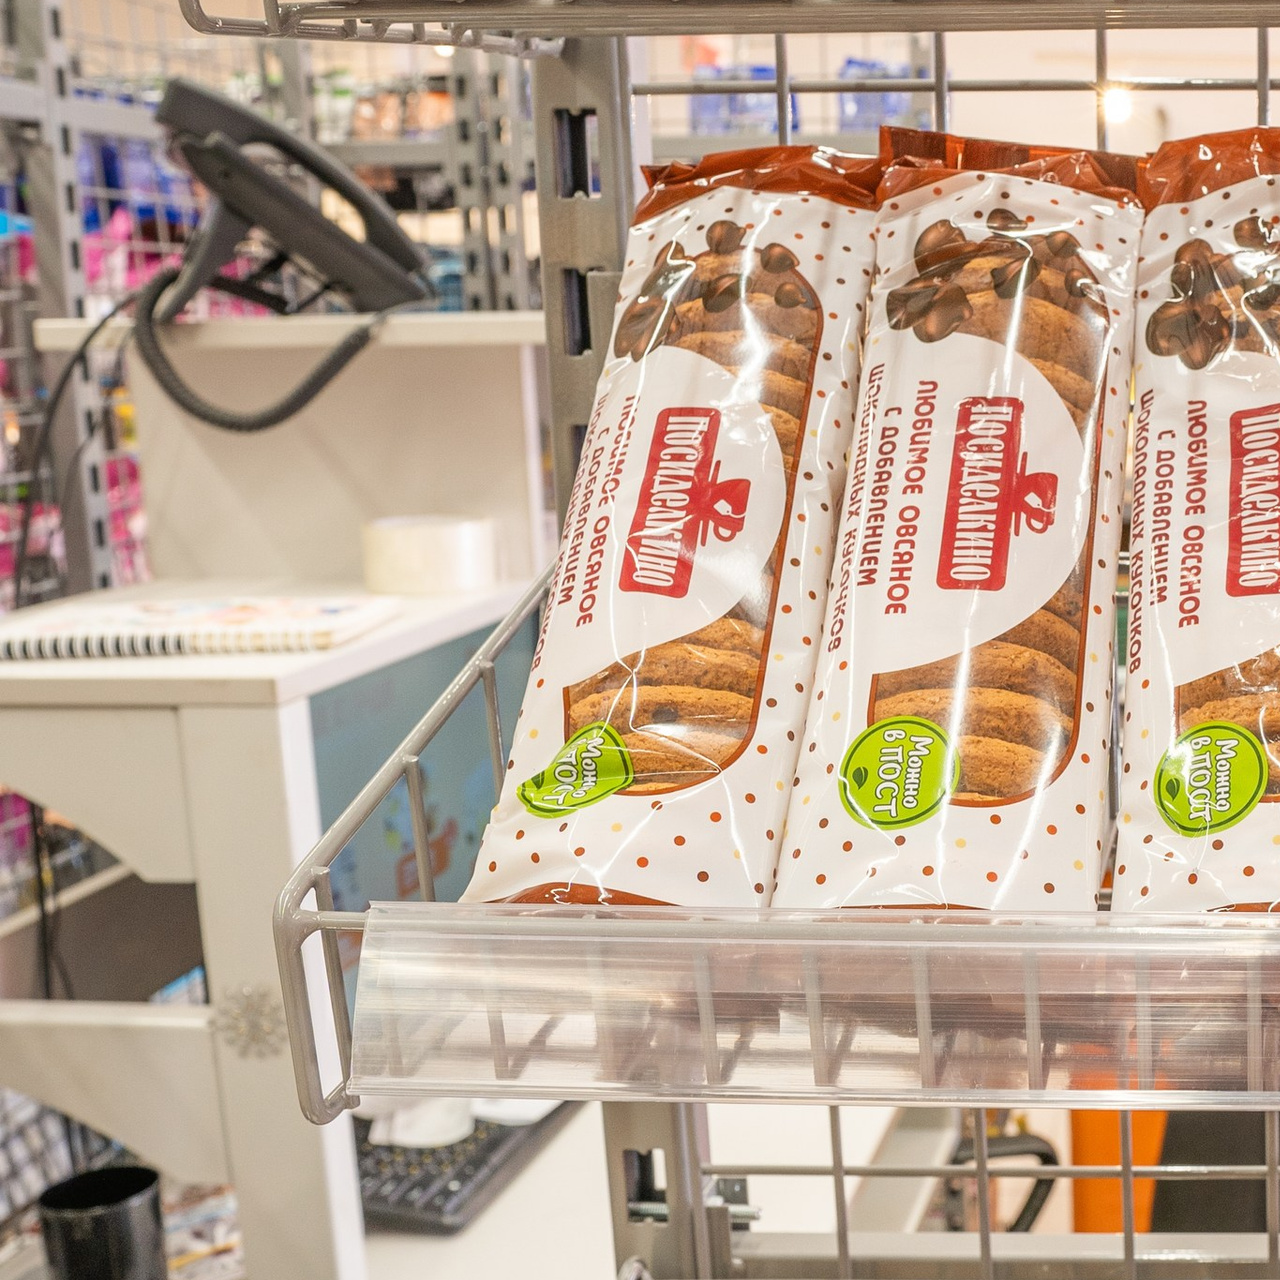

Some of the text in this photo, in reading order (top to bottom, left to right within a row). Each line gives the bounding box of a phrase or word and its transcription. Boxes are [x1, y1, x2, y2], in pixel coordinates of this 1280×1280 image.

[556, 426, 610, 607] С ДОБАВЛЕНИЕМ
[633, 414, 711, 589] ПОСИДЕЛКИНО
[856, 406, 902, 586] С ДОБАВЛЕНИЕМ
[884, 380, 939, 615] ЛЮБИМОЕ ОВСЯНОЕ
[950, 405, 1014, 582] ПОСИДЕЛКИНО
[1129, 387, 1154, 546] ШОКОЛАДНЫХ
[1148, 429, 1177, 607] С ДОБАВЛЕНИЕМ
[1177, 399, 1208, 629] ЛЮБИМОЕ ОВСЯНОЕ
[575, 514, 611, 629] ОВСЯНОЕ
[872, 729, 905, 818] в ПОСТ
[902, 734, 934, 810] Можно
[1211, 738, 1238, 813] Можно
